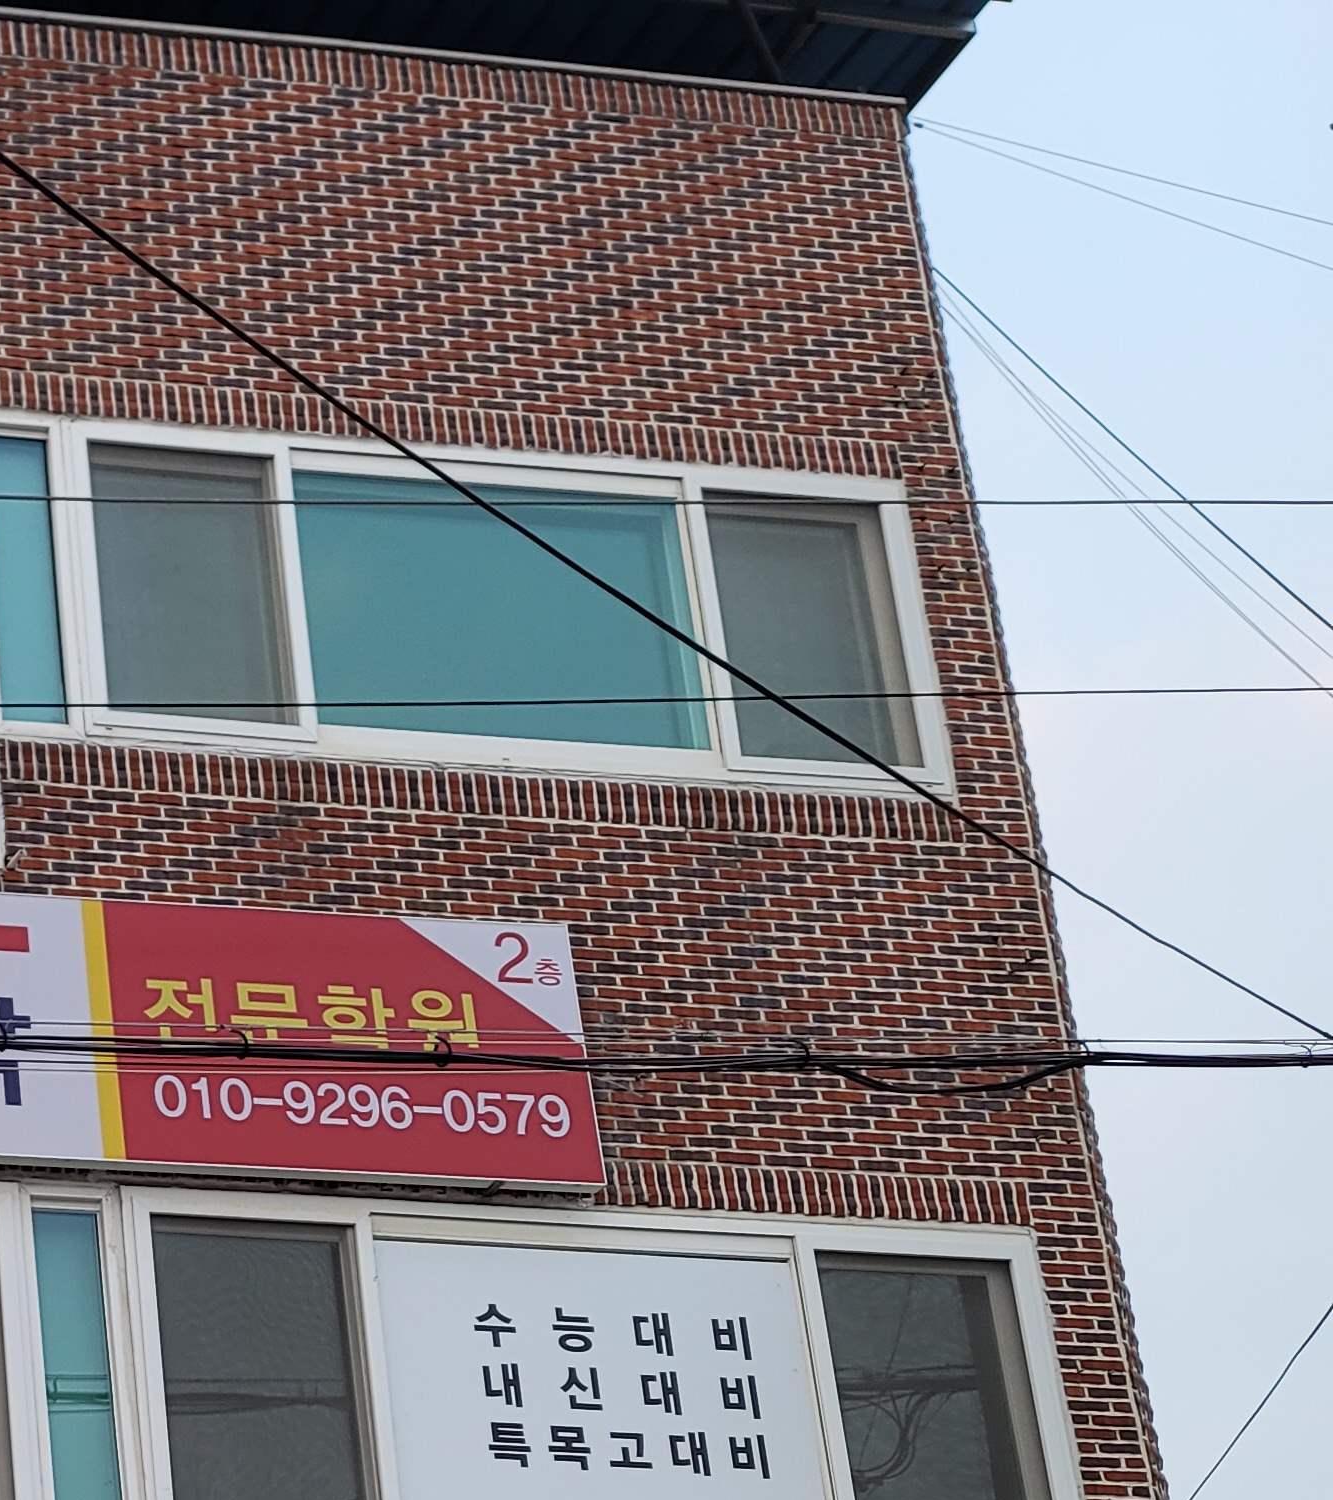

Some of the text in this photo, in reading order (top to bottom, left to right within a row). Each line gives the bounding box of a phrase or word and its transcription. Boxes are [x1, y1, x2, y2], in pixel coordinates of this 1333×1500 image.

[493, 931, 563, 987] 2층
[143, 977, 480, 1052] 전문학원
[153, 1074, 571, 1138] 010-9296-0579
